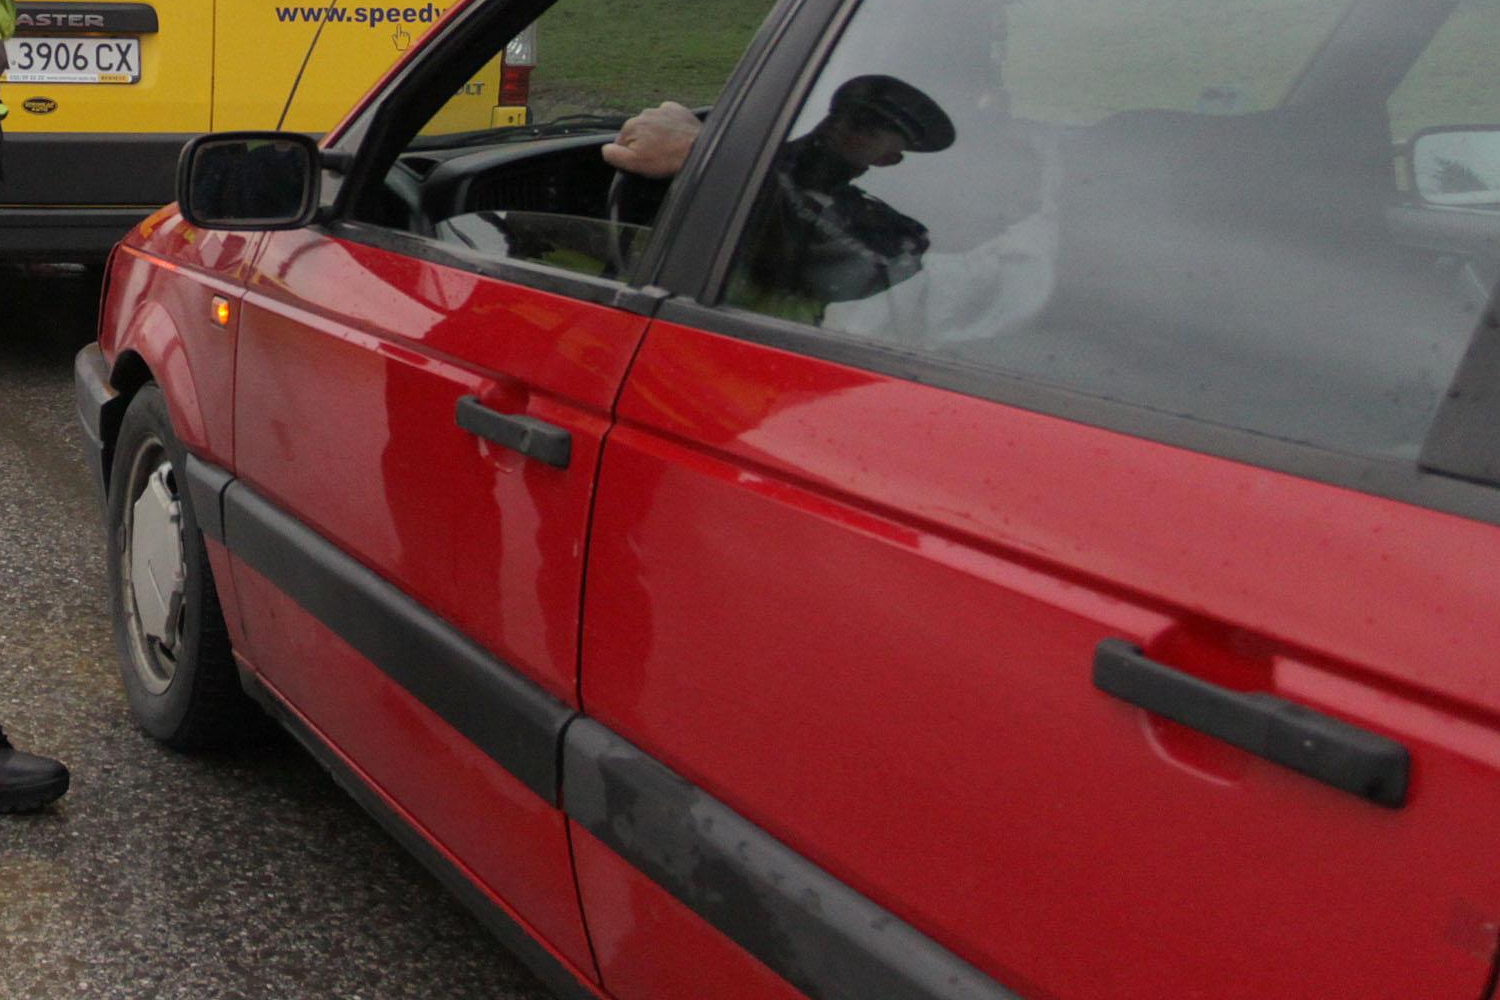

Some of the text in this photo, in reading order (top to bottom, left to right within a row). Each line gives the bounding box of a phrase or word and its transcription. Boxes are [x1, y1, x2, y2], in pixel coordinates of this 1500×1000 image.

[16, 13, 104, 27] ASTER
[18, 42, 88, 71] 3906
[95, 43, 132, 72] CX
